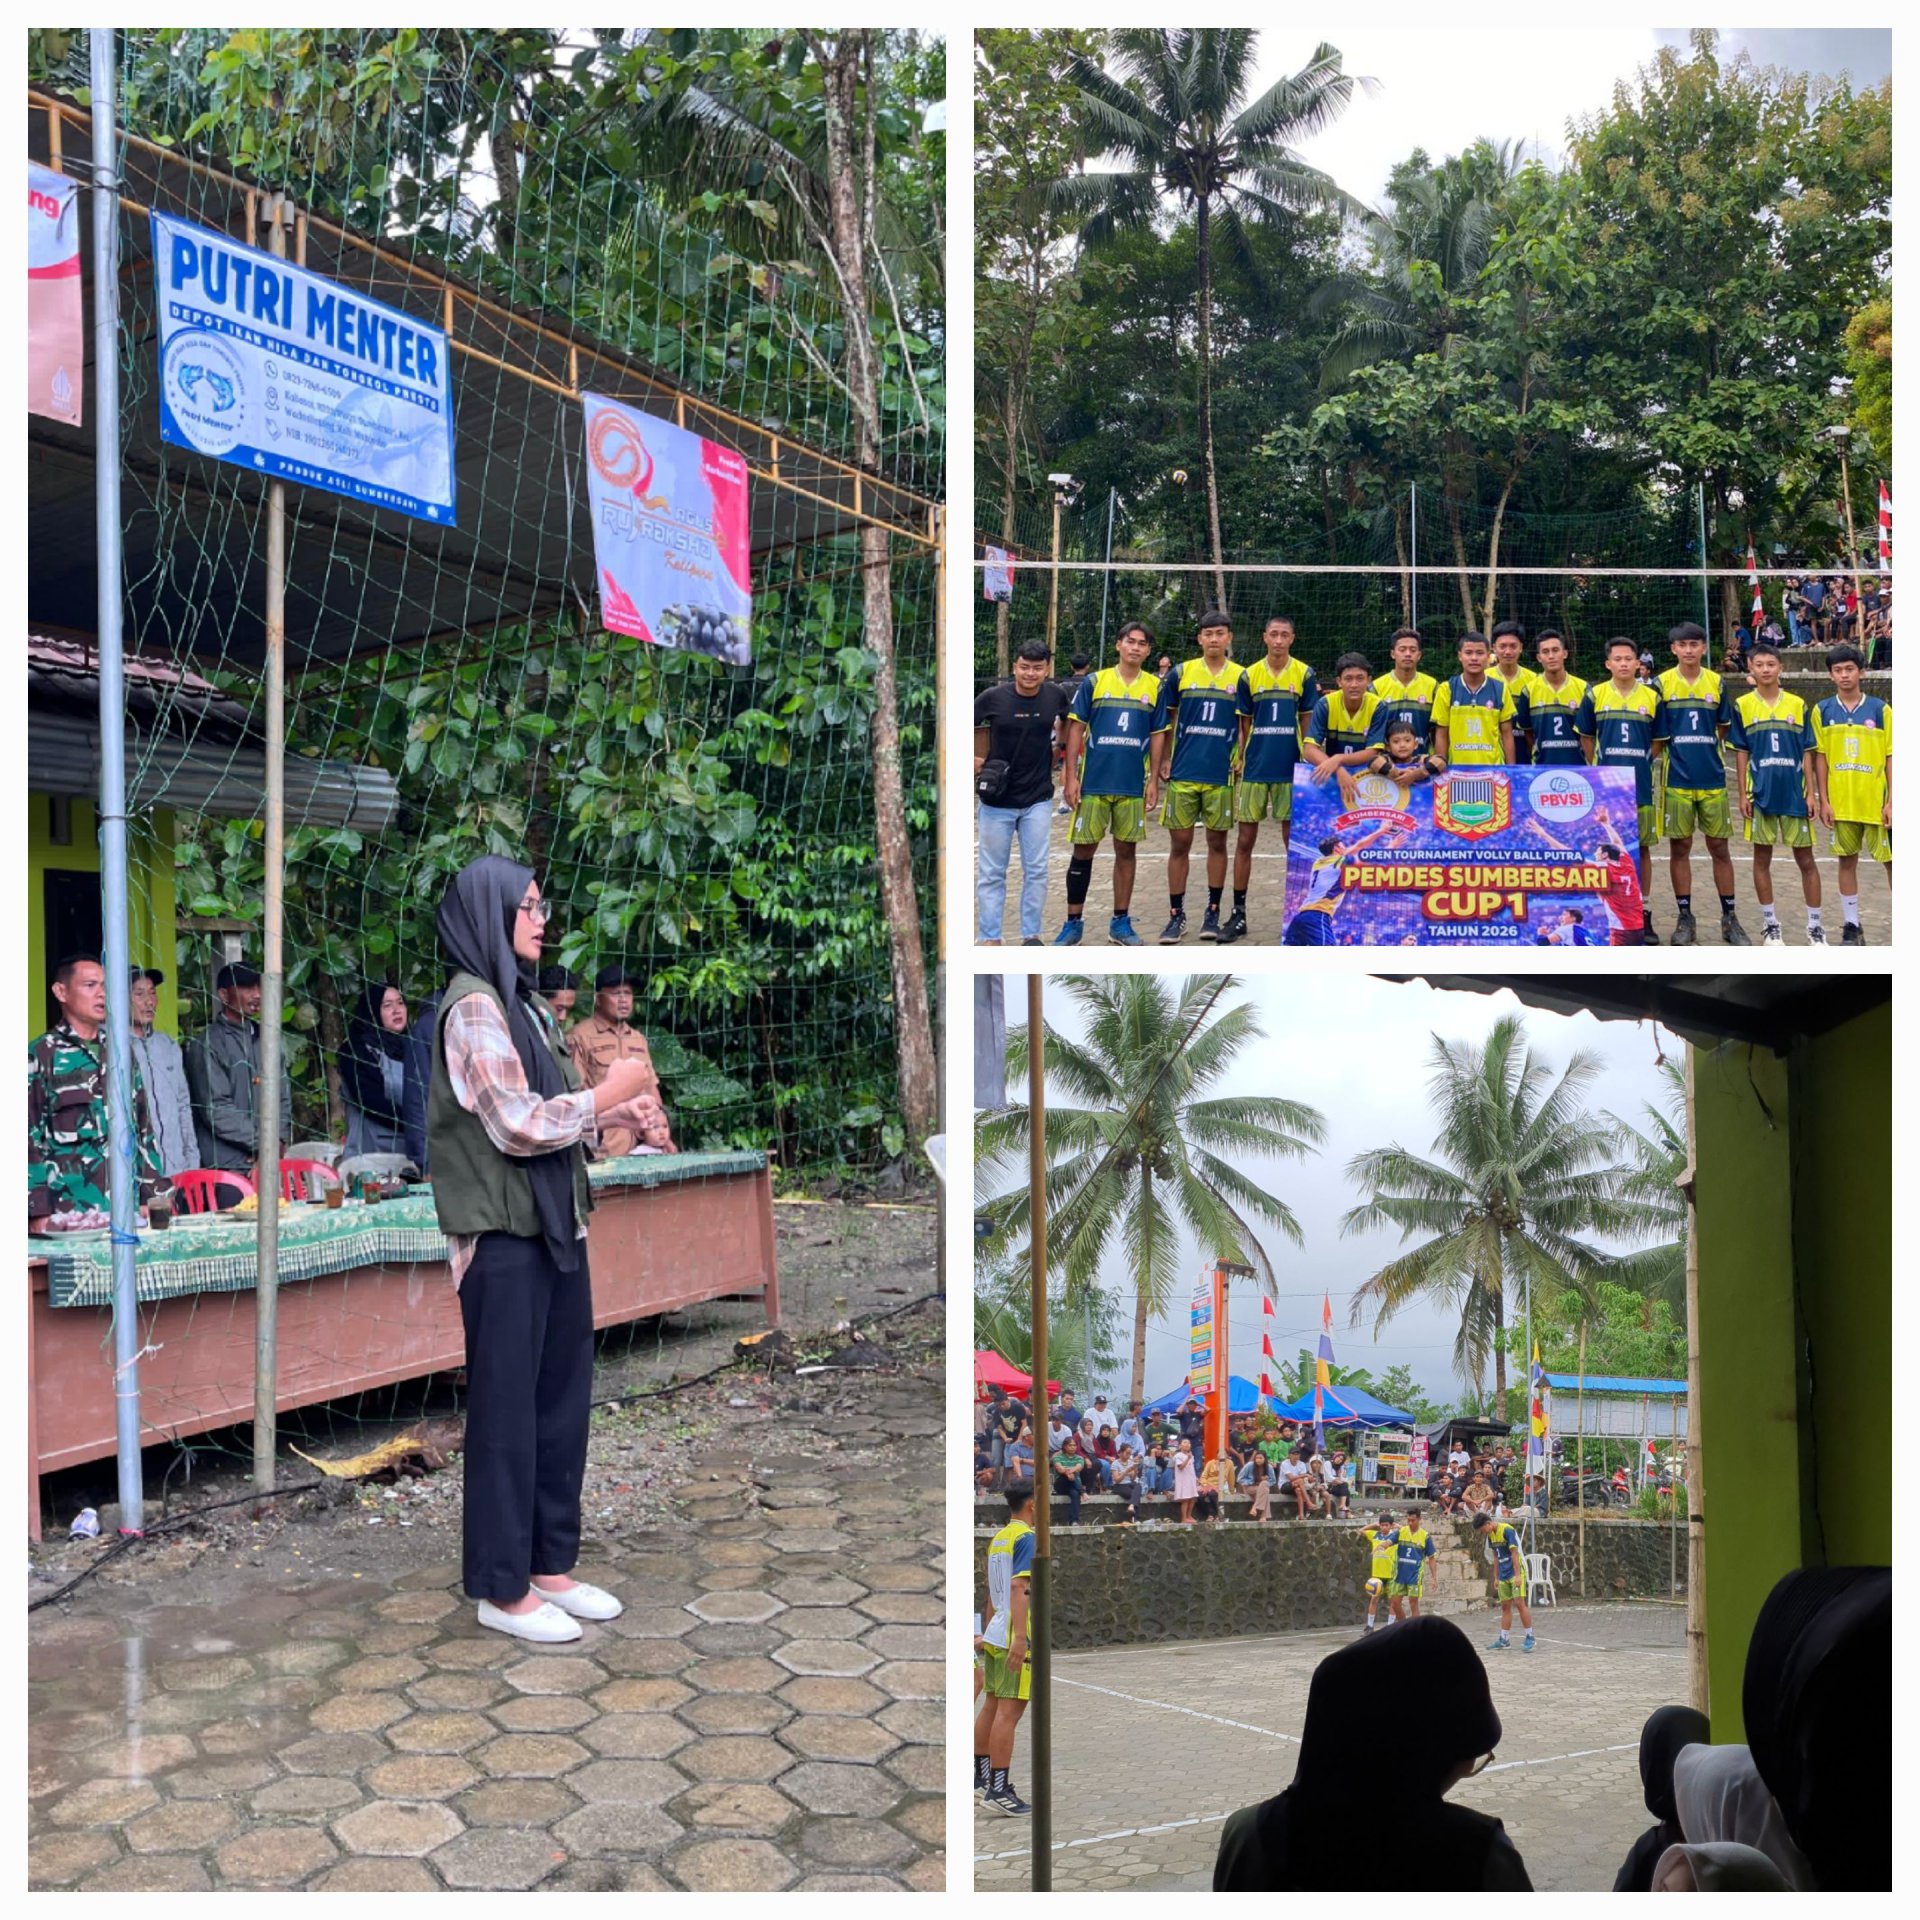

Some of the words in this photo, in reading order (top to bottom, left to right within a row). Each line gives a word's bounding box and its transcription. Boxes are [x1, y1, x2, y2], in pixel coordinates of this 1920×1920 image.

[170, 236, 293, 330] PUTRI
[306, 286, 439, 388] MENTER
[172, 305, 223, 331] DEPOT
[229, 323, 261, 345] IKAN
[279, 461, 323, 482] PRODUK
[355, 484, 418, 511] SUMBERSARI
[1117, 711, 1130, 732] 4
[1202, 701, 1217, 722] 11
[1272, 702, 1279, 722] 1
[1689, 711, 1699, 730] 7
[1553, 716, 1563, 735] 2
[1620, 722, 1629, 743] 5
[1770, 733, 1780, 752] 6
[1540, 793, 1583, 806] PBVSI
[1347, 810, 1406, 822] SUMBERSARI
[1360, 850, 1394, 860] OPEN
[1395, 850, 1475, 860] TOURNAMENT
[1476, 850, 1512, 860] VOLLY
[1513, 851, 1543, 860] BALL
[1544, 851, 1583, 861] PUTRA
[1344, 867, 1443, 887] PEMDES
[1449, 867, 1608, 889] SUMBERSARI
[1427, 892, 1501, 917] CUP
[1507, 893, 1525, 916] 1
[1428, 925, 1479, 937] TAHUN
[1481, 925, 1518, 937] 2026
